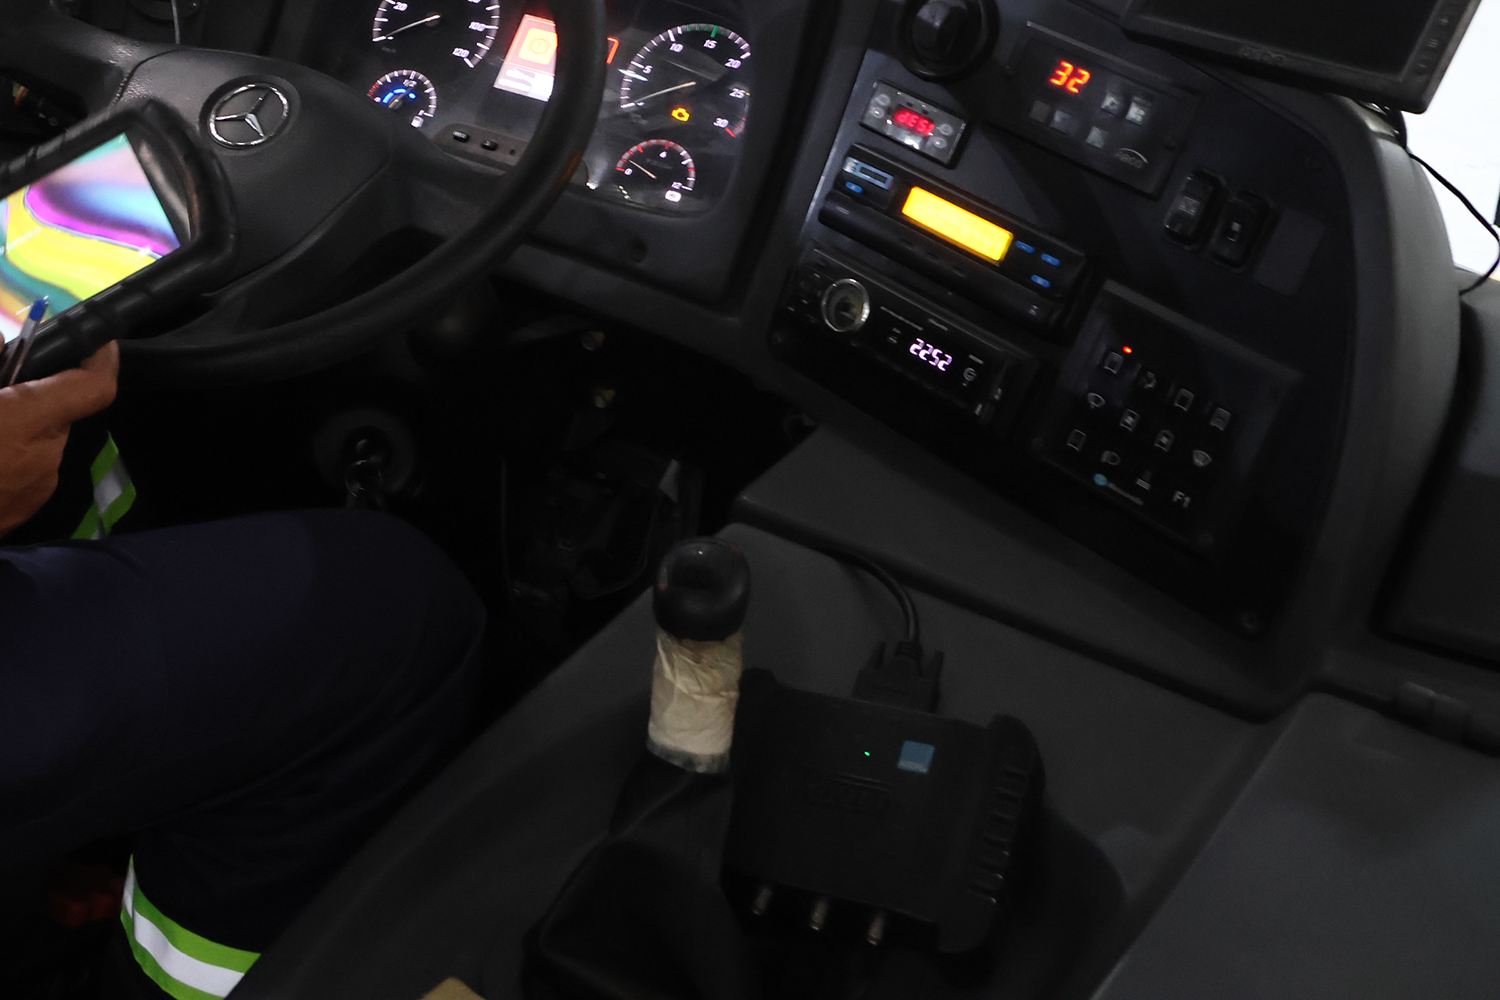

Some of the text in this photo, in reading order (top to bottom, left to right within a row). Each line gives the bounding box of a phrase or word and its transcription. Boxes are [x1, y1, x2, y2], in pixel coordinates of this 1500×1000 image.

[669, 43, 684, 53] 10
[703, 39, 718, 49] 15
[724, 58, 742, 69] 20
[642, 65, 653, 74] 5
[1050, 60, 1091, 94] 32
[729, 87, 747, 98] 25
[713, 117, 729, 128] 30
[909, 337, 953, 372] 2252
[1172, 490, 1191, 508] F1
